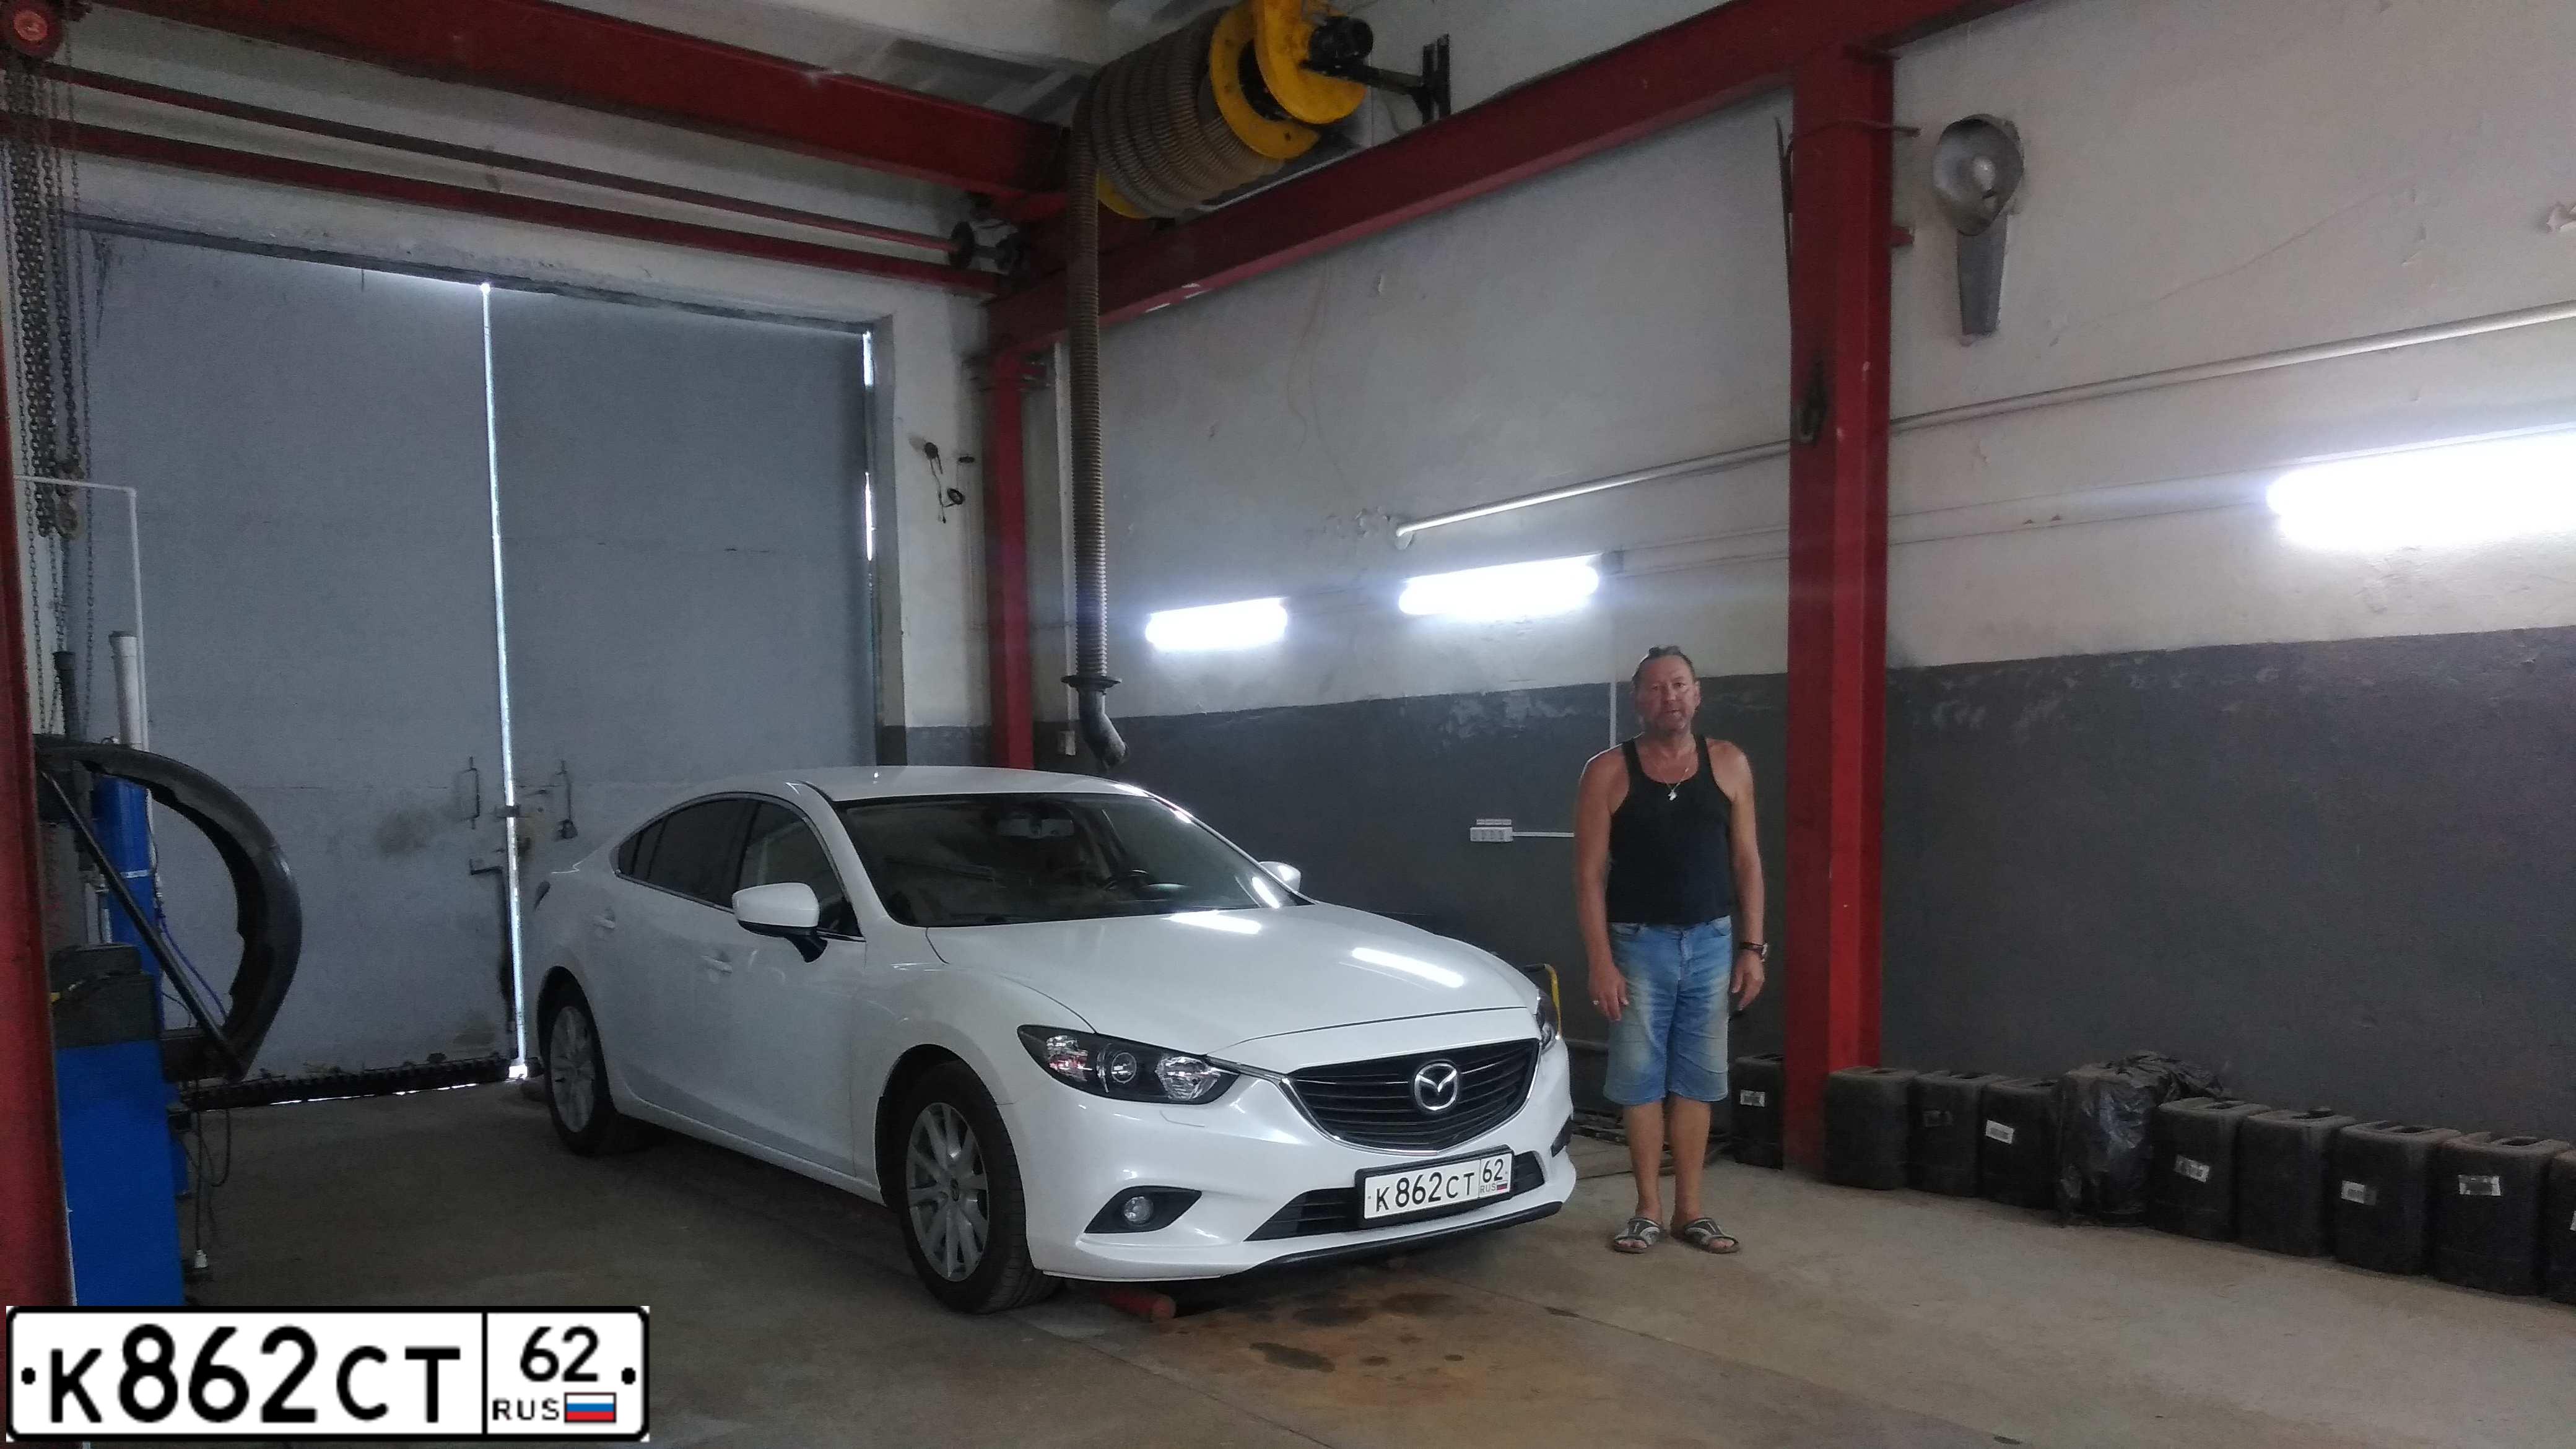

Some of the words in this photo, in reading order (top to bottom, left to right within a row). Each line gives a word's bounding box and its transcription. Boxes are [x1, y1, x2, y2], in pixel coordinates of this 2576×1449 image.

[1375, 1172, 1475, 1212] K862CT
[1482, 1159, 1503, 1183] 62
[1480, 1183, 1496, 1193] RUS
